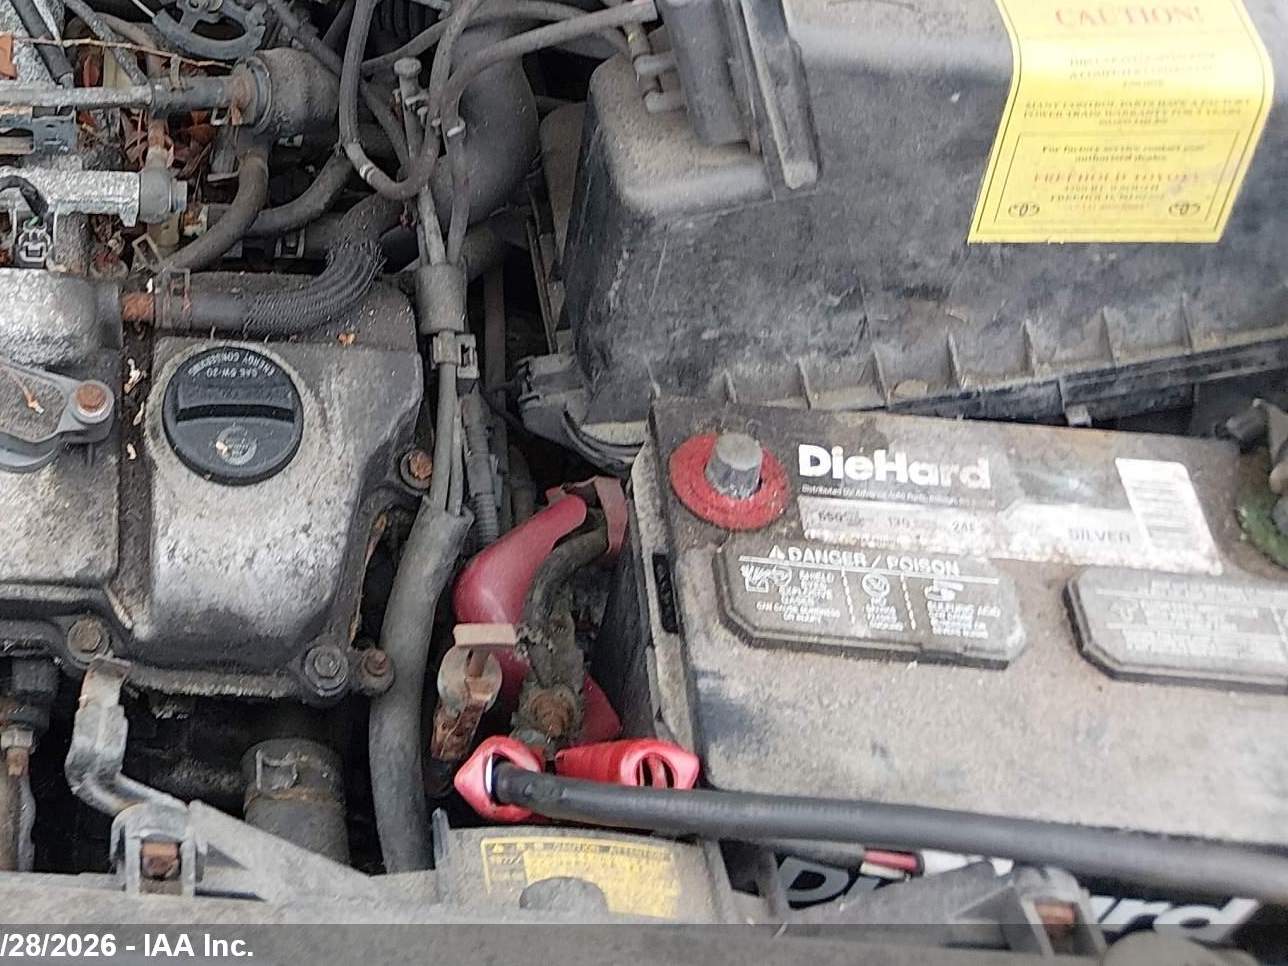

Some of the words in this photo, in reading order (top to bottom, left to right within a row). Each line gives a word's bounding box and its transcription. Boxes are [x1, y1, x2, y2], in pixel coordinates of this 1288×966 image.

[1054, 4, 1207, 27] CAUTION!
[797, 443, 992, 491] DieHard
[1067, 527, 1131, 544] SILVER
[788, 545, 867, 567] DANGER
[886, 555, 961, 577] POISON
